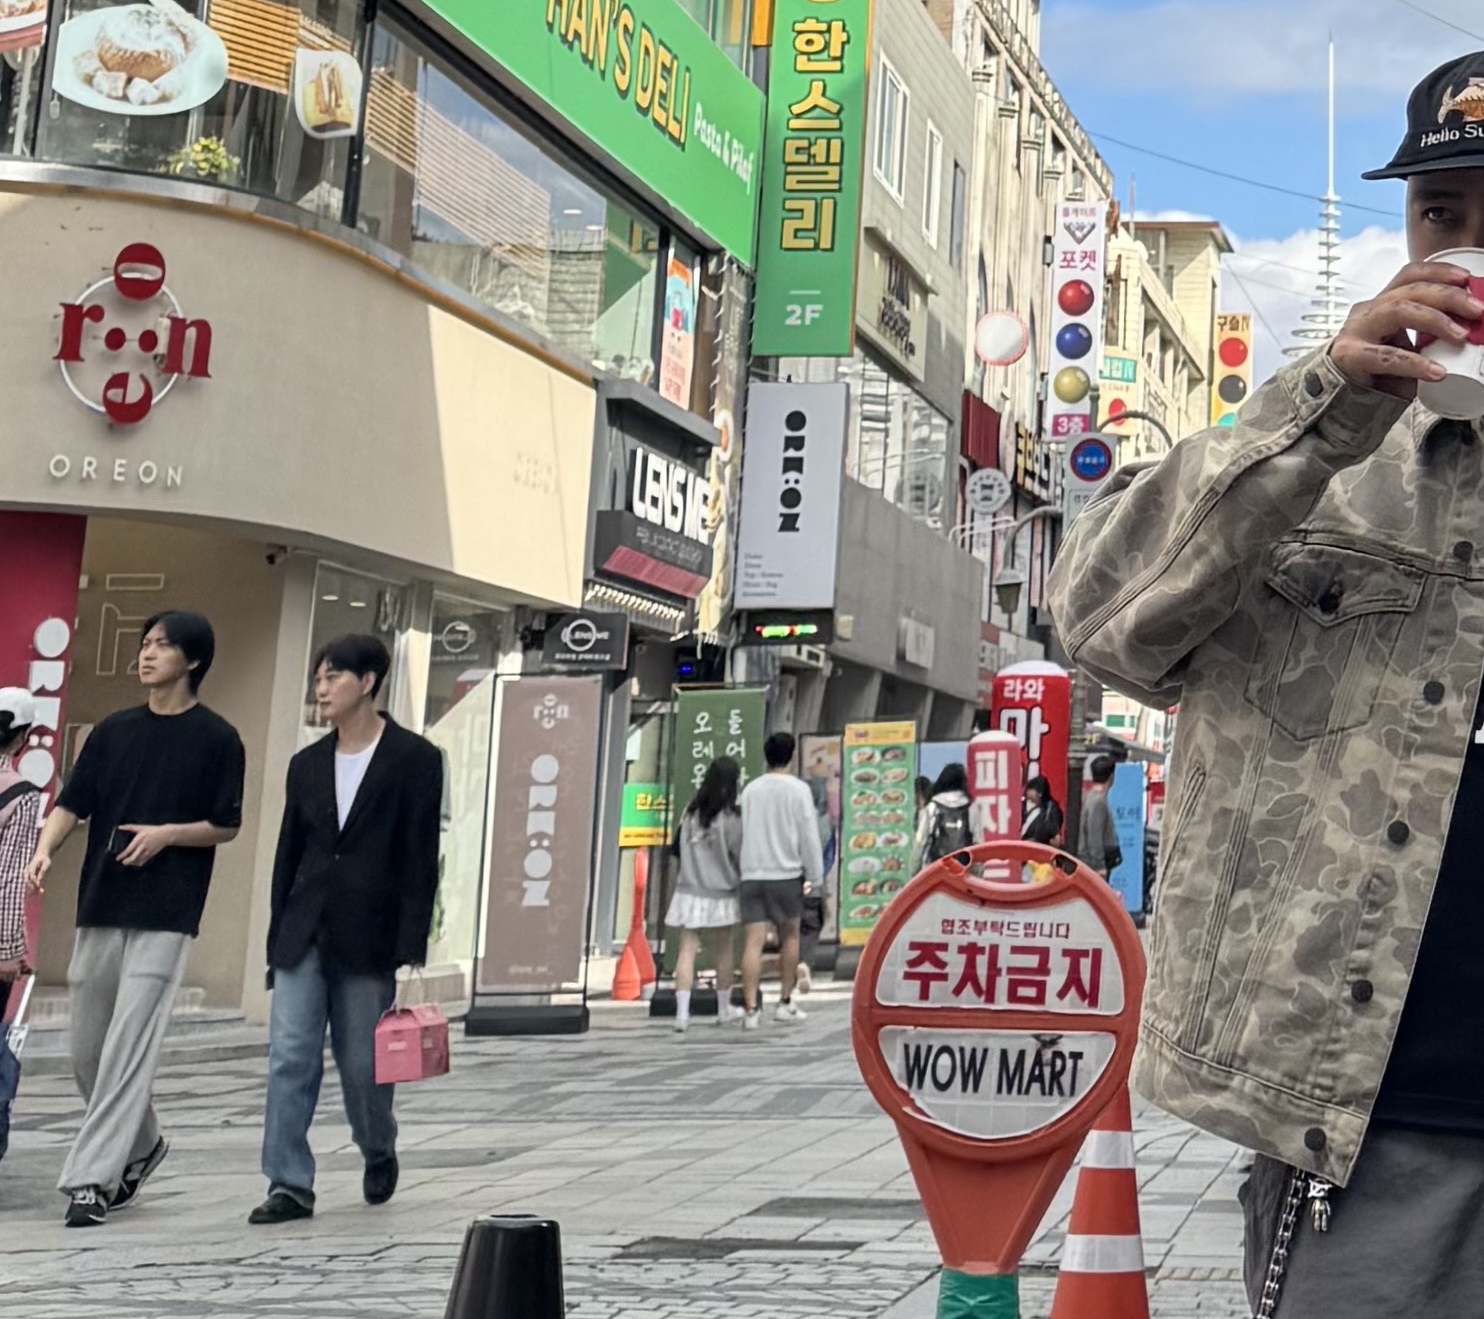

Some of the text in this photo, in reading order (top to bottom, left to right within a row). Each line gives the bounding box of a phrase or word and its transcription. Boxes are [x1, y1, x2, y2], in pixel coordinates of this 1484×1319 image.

[635, 20, 691, 152] DELI
[693, 102, 722, 157] Pasta
[730, 138, 755, 194] Pilaf
[780, 17, 850, 251] 한스델리
[1419, 126, 1460, 148] Hello
[1058, 249, 1097, 272] 포켓
[784, 303, 823, 326] 2F
[49, 454, 183, 486] OREON
[632, 447, 687, 534] LENS
[940, 918, 1071, 940] 협조부탁드립니다
[902, 940, 1103, 1010] 주차금지
[903, 1043, 1084, 1097] WOW MART
